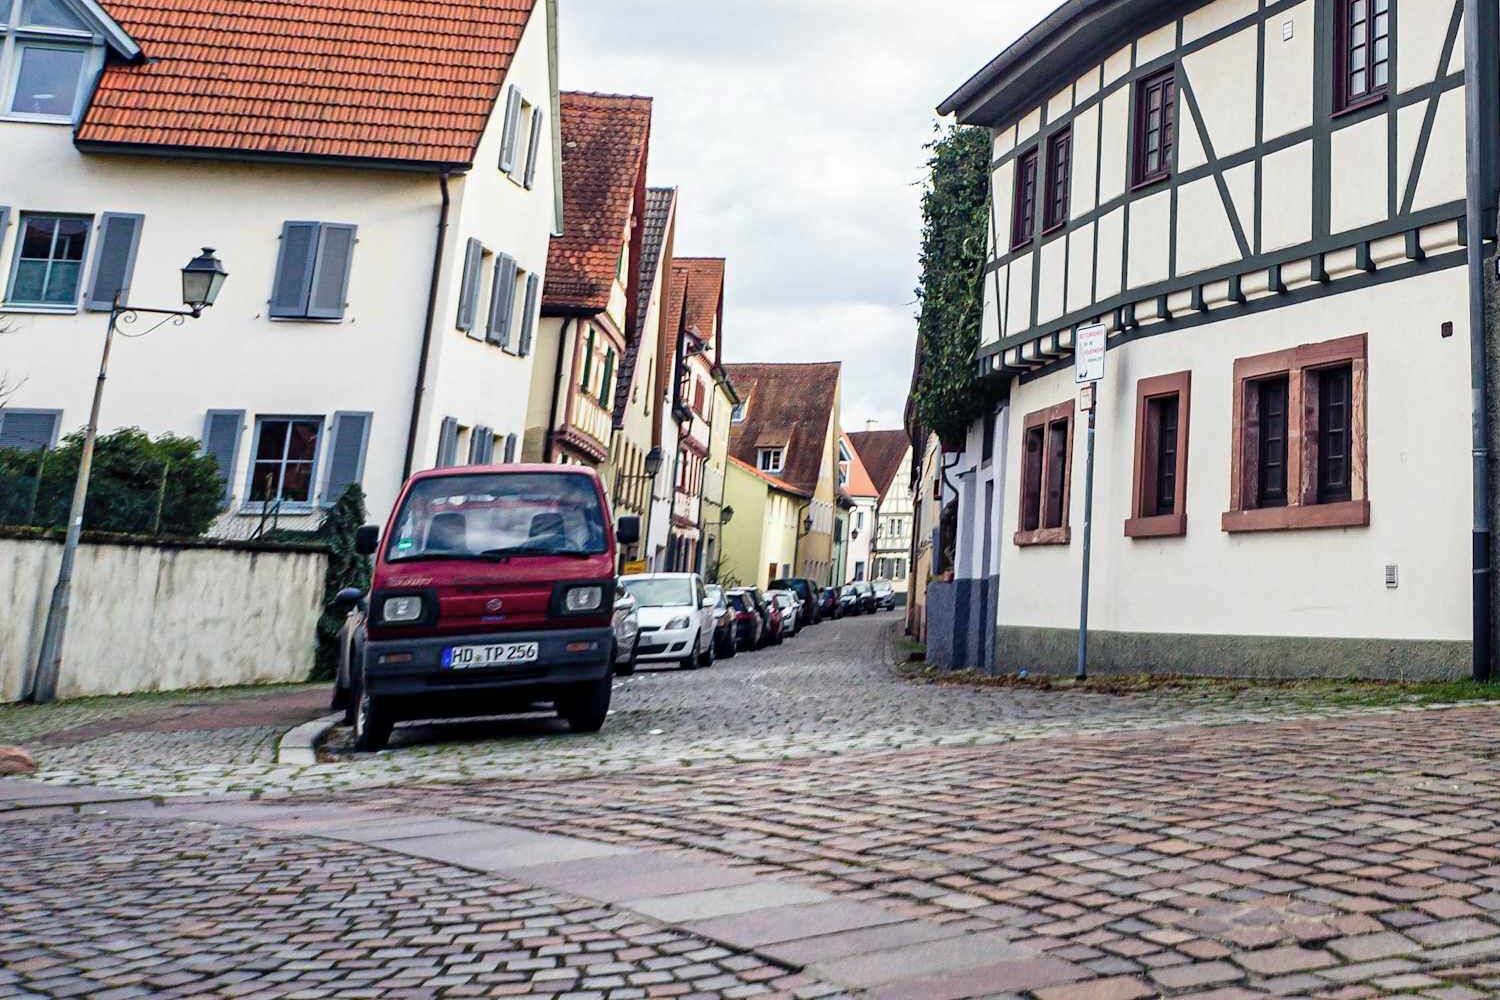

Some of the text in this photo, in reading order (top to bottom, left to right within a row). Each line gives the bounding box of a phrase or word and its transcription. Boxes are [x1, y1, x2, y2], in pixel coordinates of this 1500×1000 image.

[452, 644, 535, 663] HD TP 256
